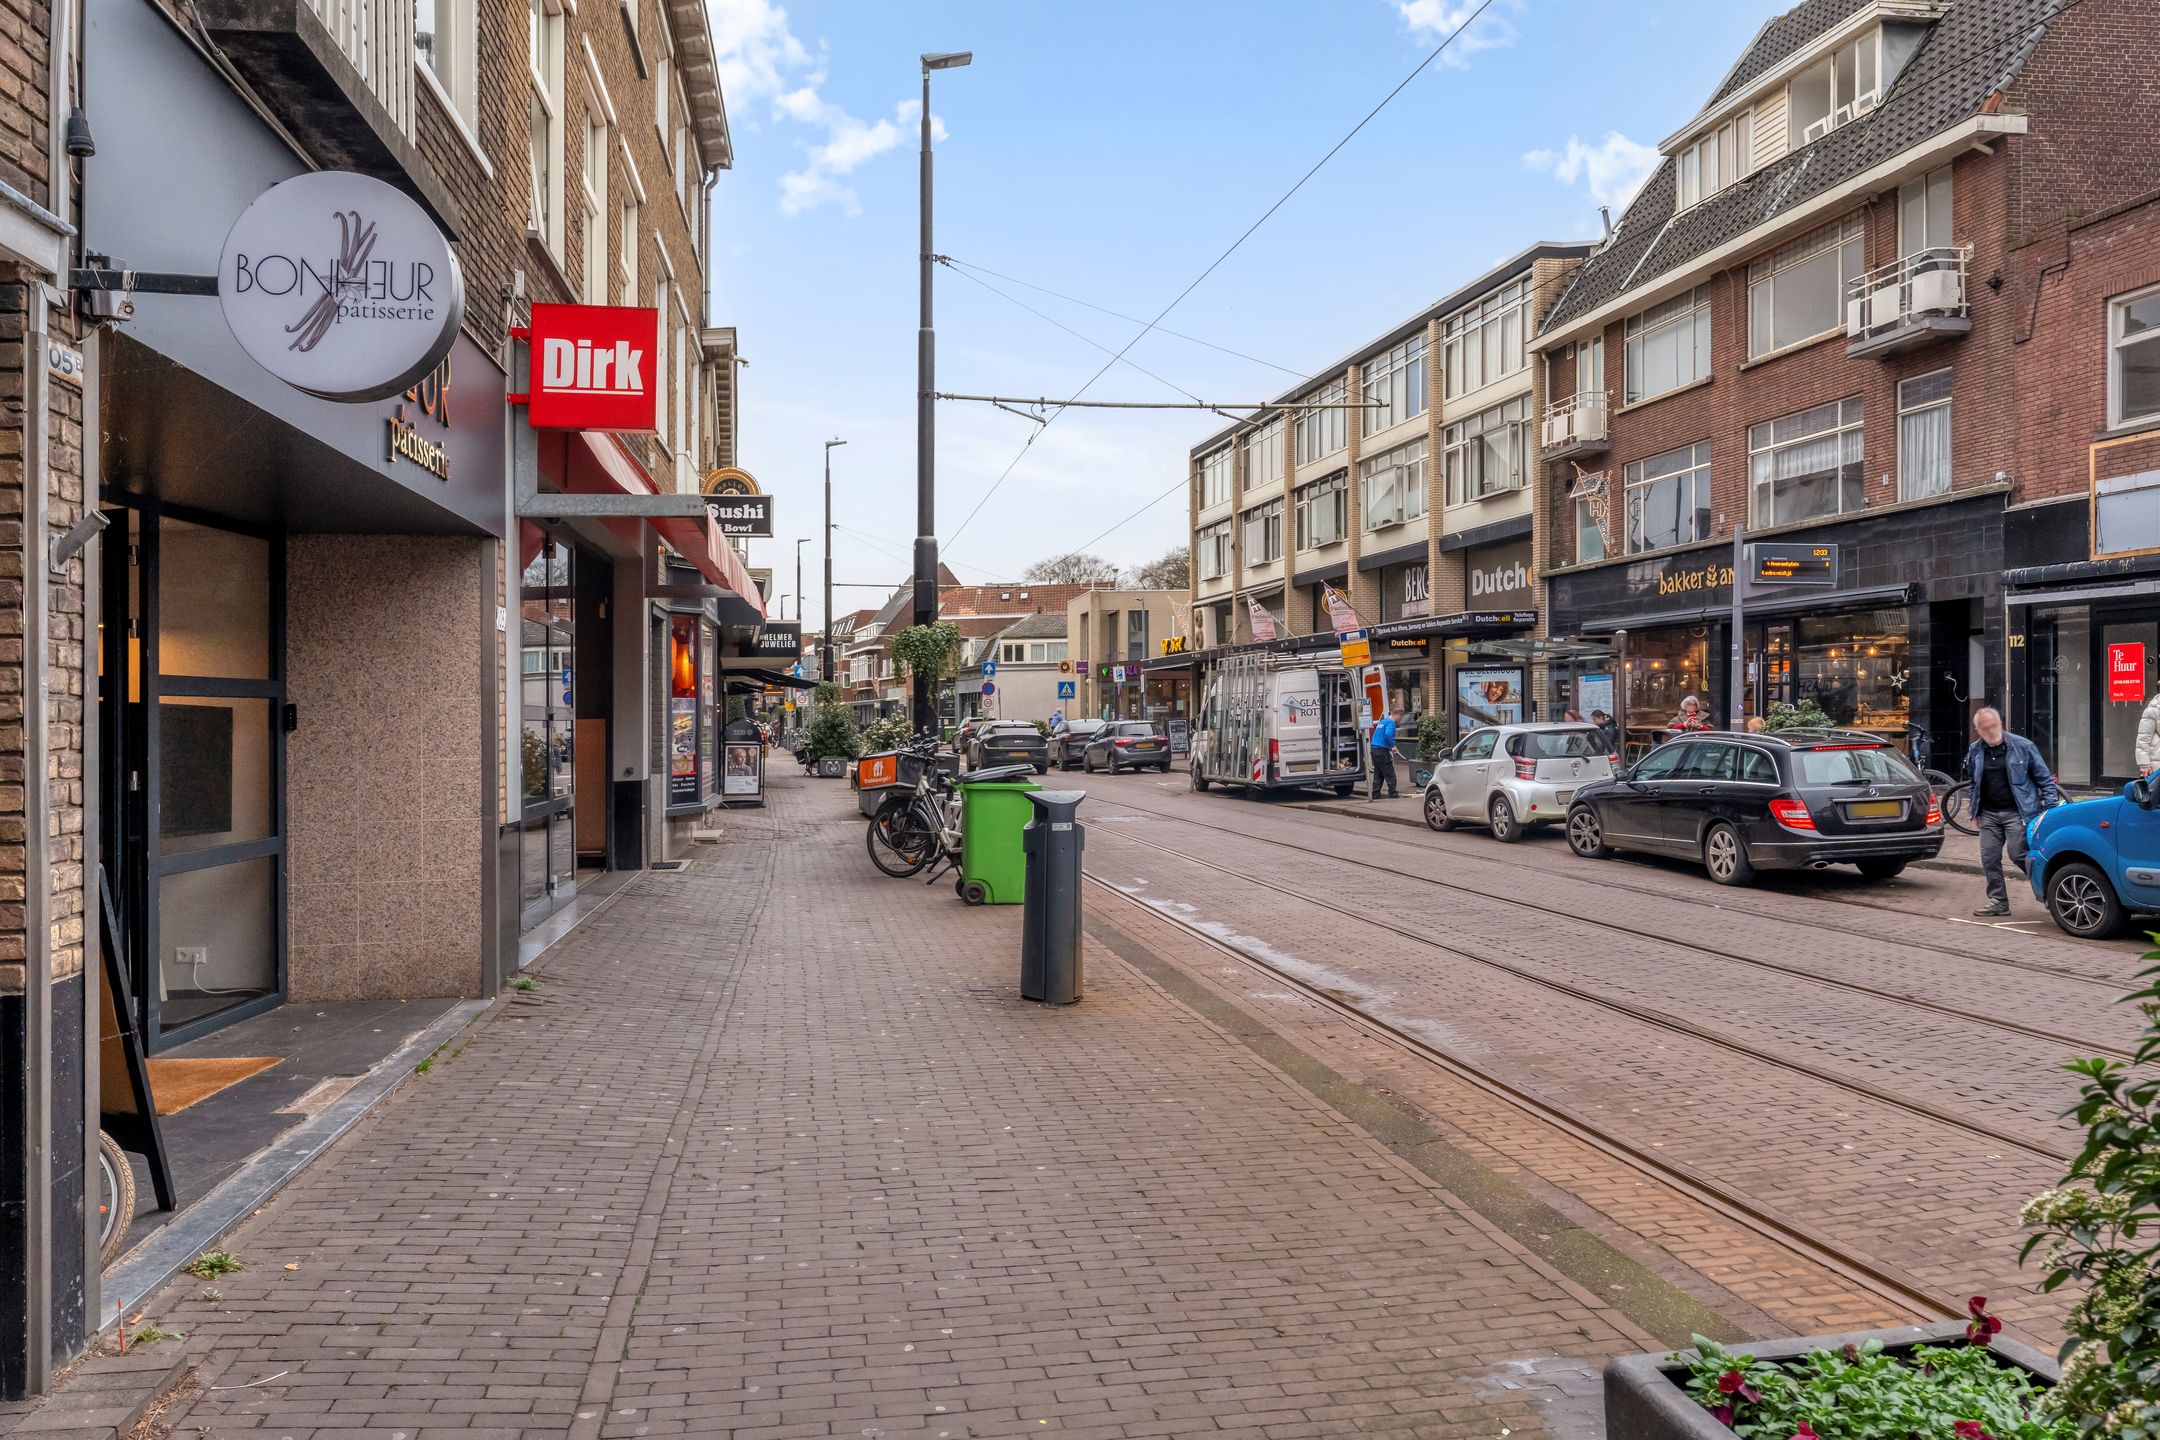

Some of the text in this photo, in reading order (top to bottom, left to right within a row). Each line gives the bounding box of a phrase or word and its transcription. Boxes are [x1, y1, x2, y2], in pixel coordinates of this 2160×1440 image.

[335, 298, 434, 324] pâtisserie
[543, 338, 644, 390] Dirk
[707, 503, 764, 519] Sushi
[724, 523, 753, 532] Bowl
[1659, 570, 1704, 596] bakker
[764, 633, 793, 641] HELMER
[1391, 639, 1427, 647] Dutchcell
[2008, 634, 2025, 648] 112
[760, 640, 797, 648] JUWELIER
[2113, 649, 2125, 661] Te
[2113, 660, 2137, 672] Huur
